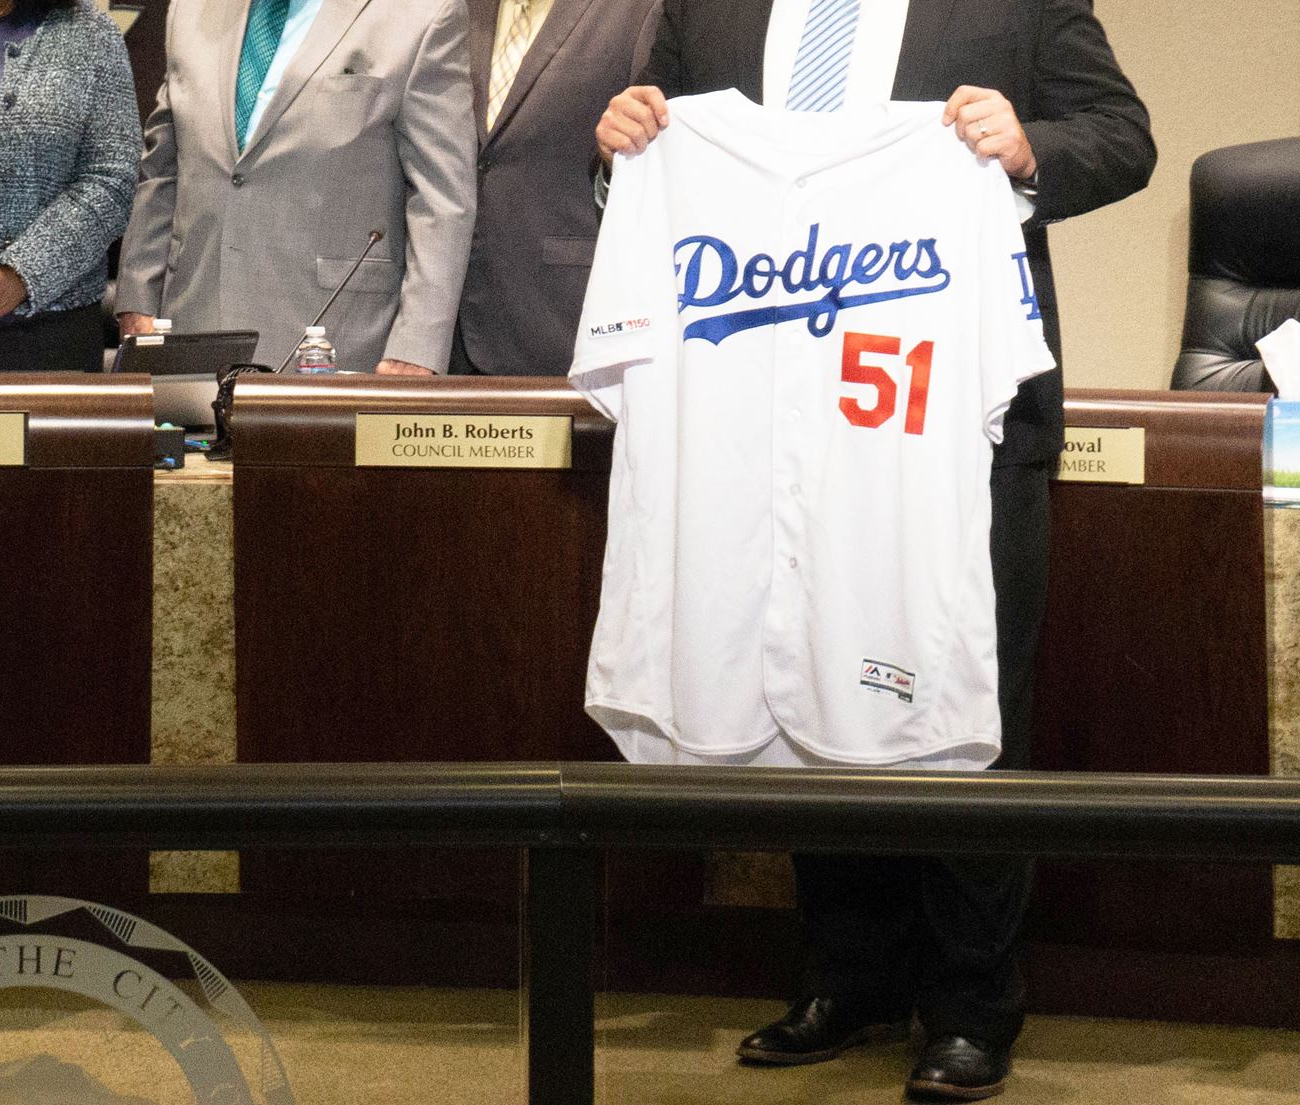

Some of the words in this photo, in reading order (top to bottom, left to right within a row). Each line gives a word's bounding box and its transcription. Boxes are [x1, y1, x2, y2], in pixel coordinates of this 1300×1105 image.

[673, 222, 951, 345] Dodgers
[590, 323, 616, 336] MLB
[838, 331, 935, 437] 51
[394, 422, 436, 440] John
[443, 424, 459, 439] B.
[465, 423, 534, 440] Roberts
[391, 443, 465, 458] COUNCIL
[468, 444, 535, 458] MEMBER
[1064, 437, 1102, 453] oval
[1060, 459, 1106, 473] MBER
[112, 969, 213, 1049] CITY
